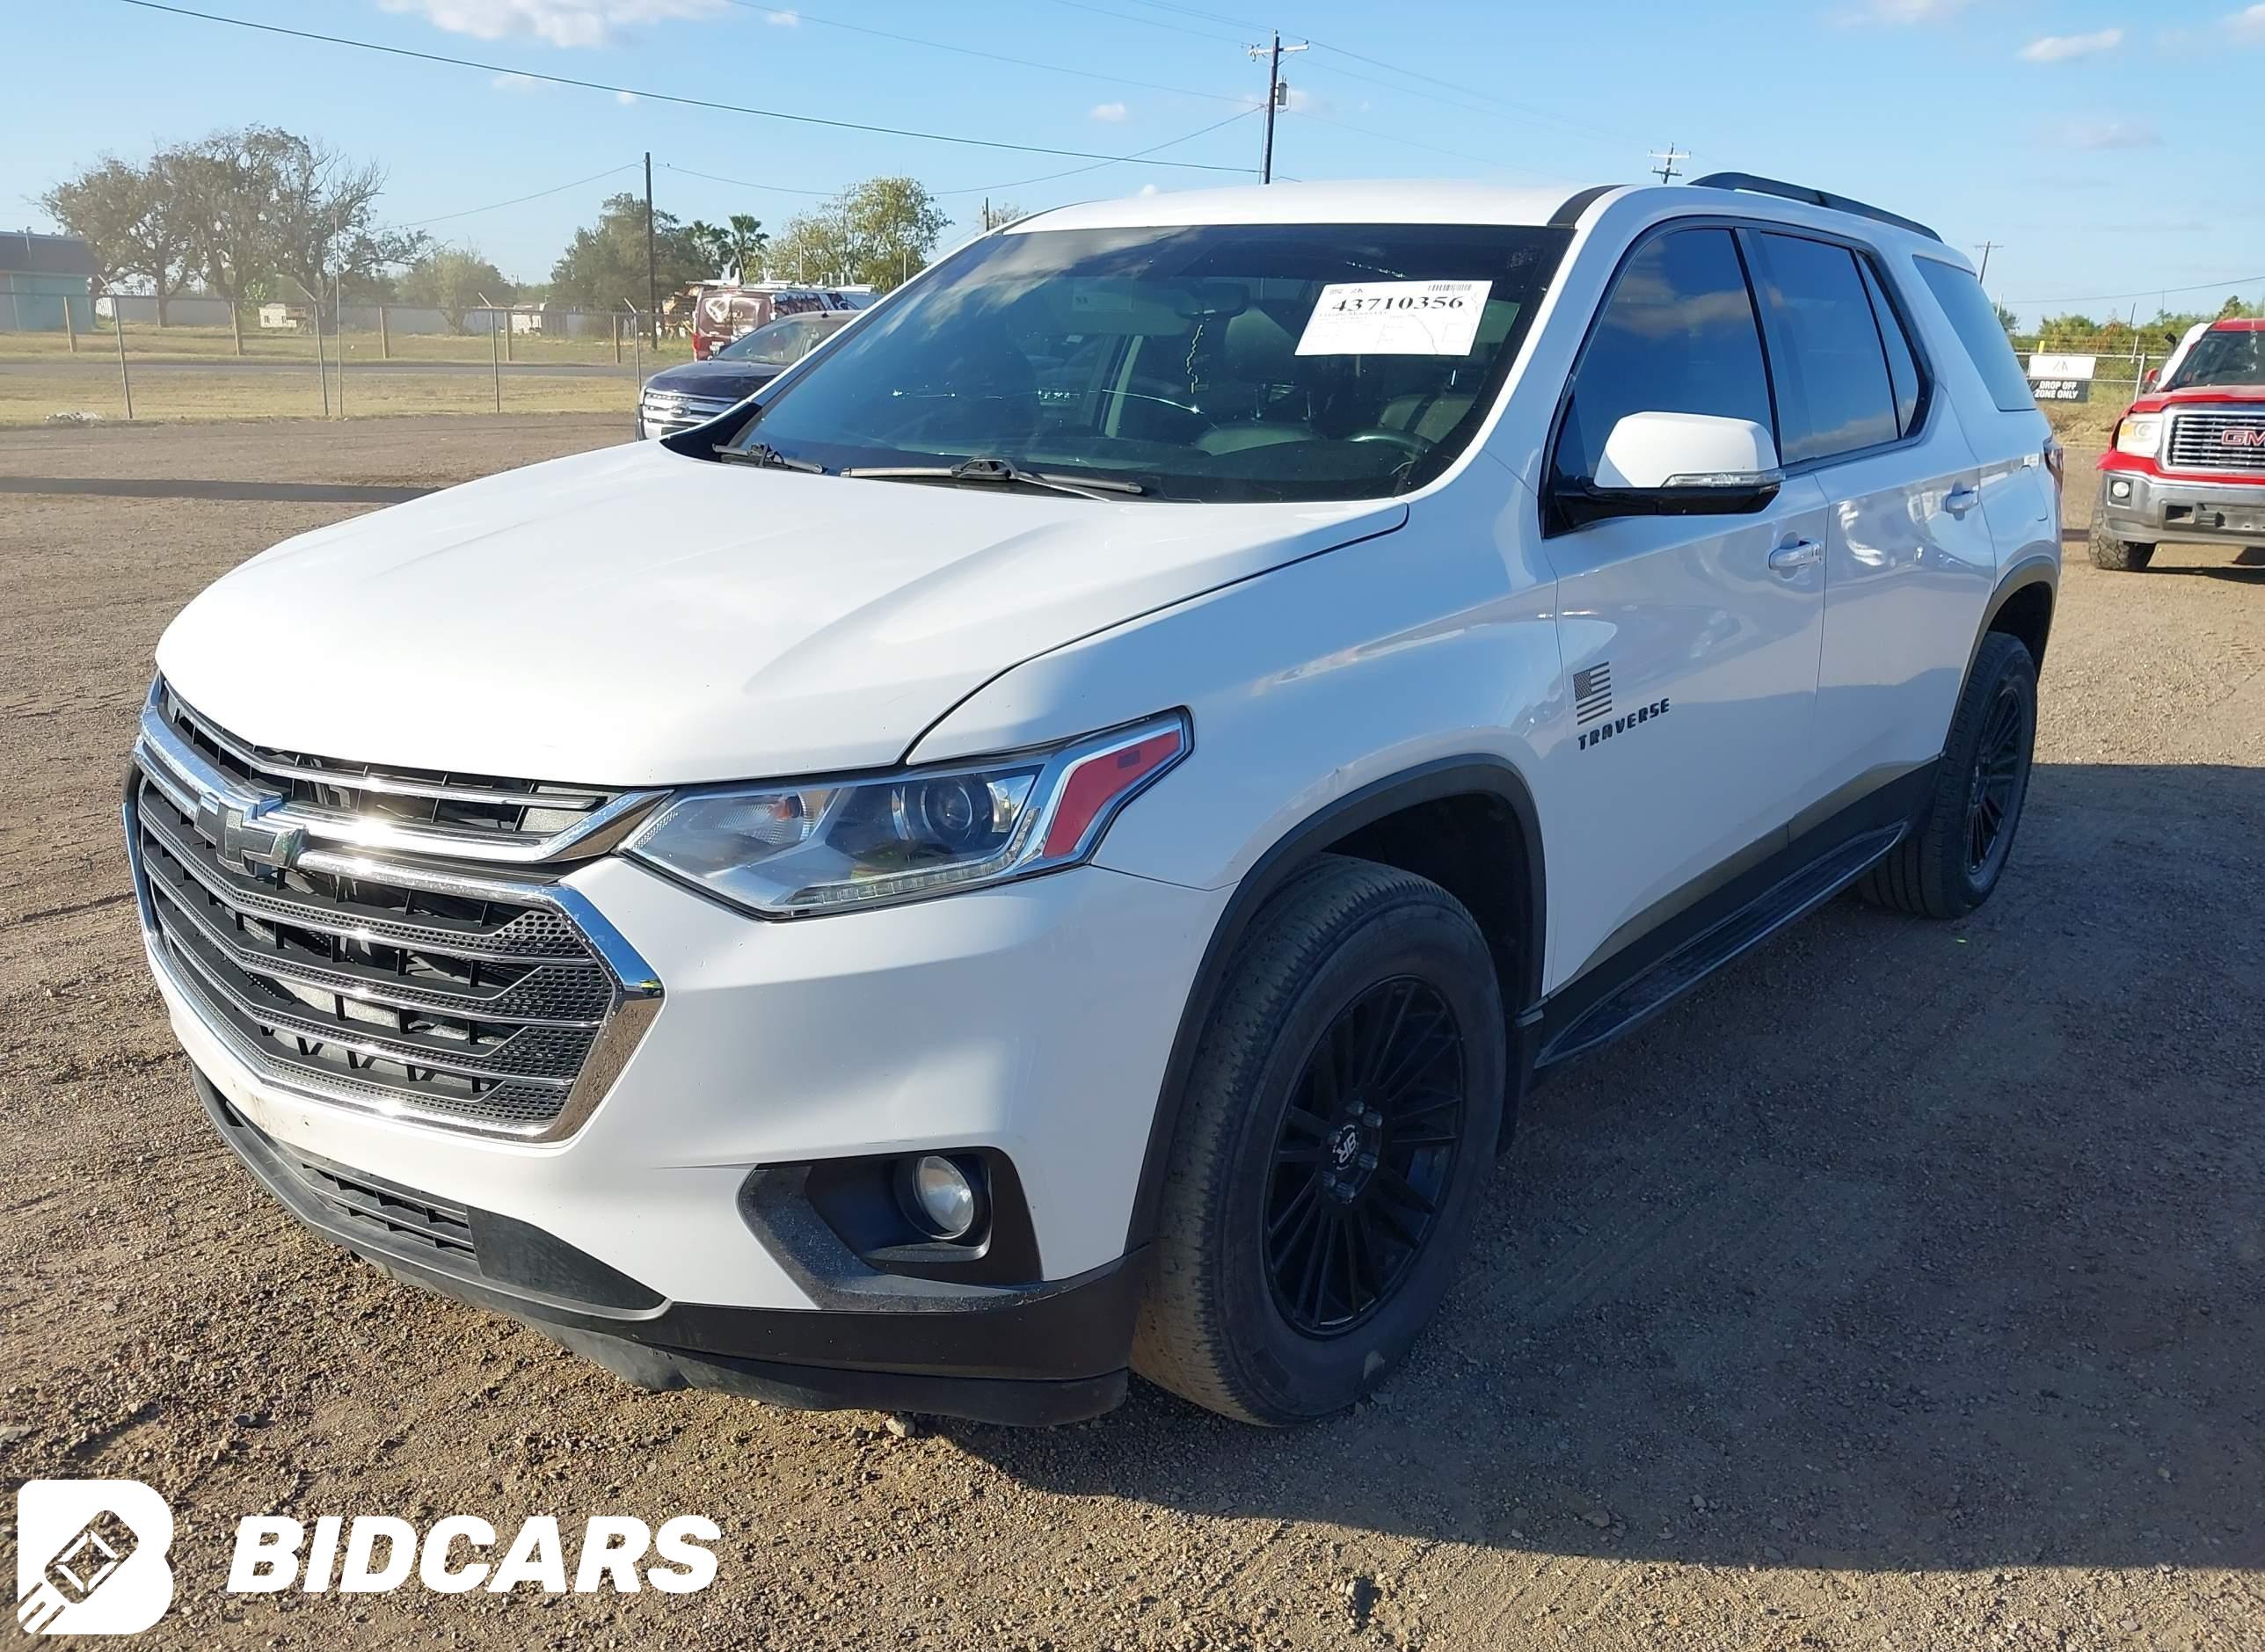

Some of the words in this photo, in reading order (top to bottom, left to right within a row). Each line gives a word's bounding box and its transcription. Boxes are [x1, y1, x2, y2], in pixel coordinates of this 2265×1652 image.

[1331, 296, 1464, 312] 43710356
[2039, 381, 2062, 390] DROP
[2062, 381, 2078, 390] OFF
[2034, 389, 2057, 398] ZONE
[2057, 389, 2079, 399] ONLY
[1577, 698, 1670, 751] TRAVERSE
